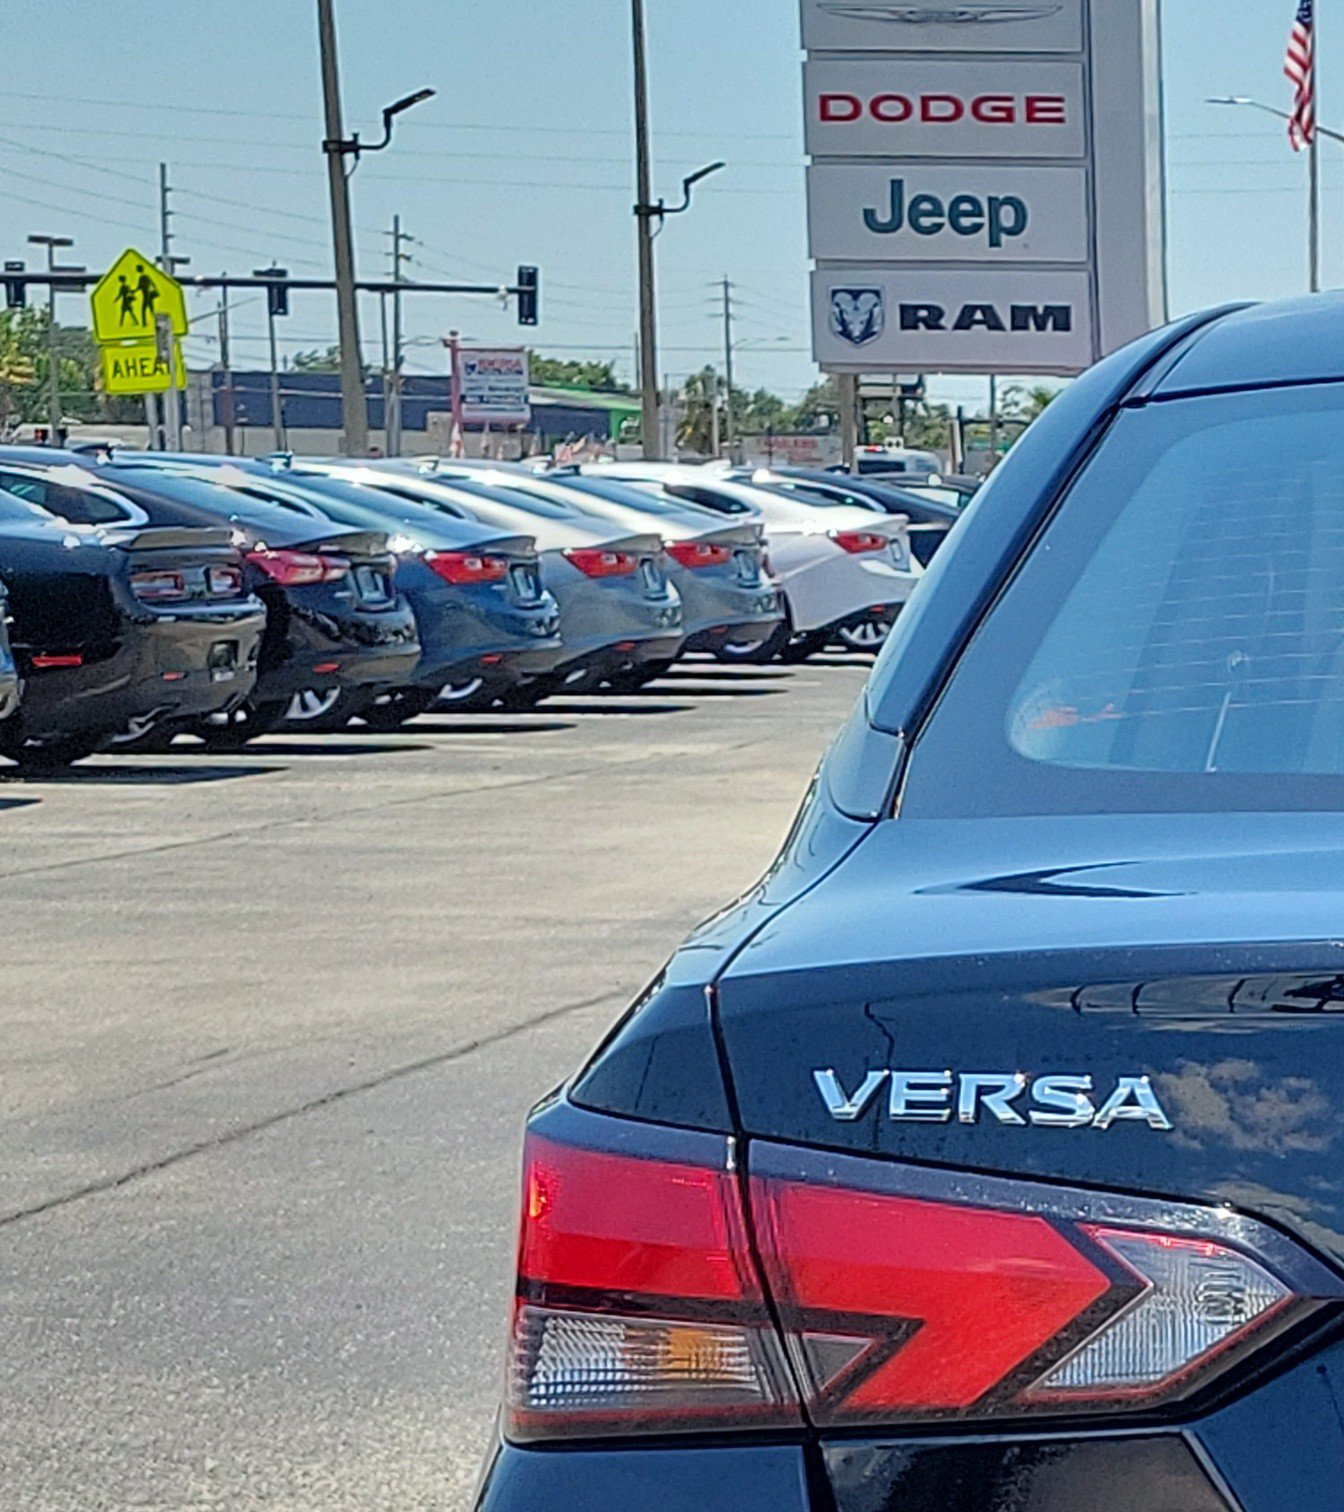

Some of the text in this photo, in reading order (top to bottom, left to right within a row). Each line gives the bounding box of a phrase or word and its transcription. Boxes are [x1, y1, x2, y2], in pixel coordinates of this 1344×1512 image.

[819, 94, 1065, 123] DODGE
[863, 179, 1028, 248] Jeep
[899, 304, 1072, 332] RAM
[112, 357, 171, 378] AHEA
[813, 1069, 1174, 1130] VERSA
